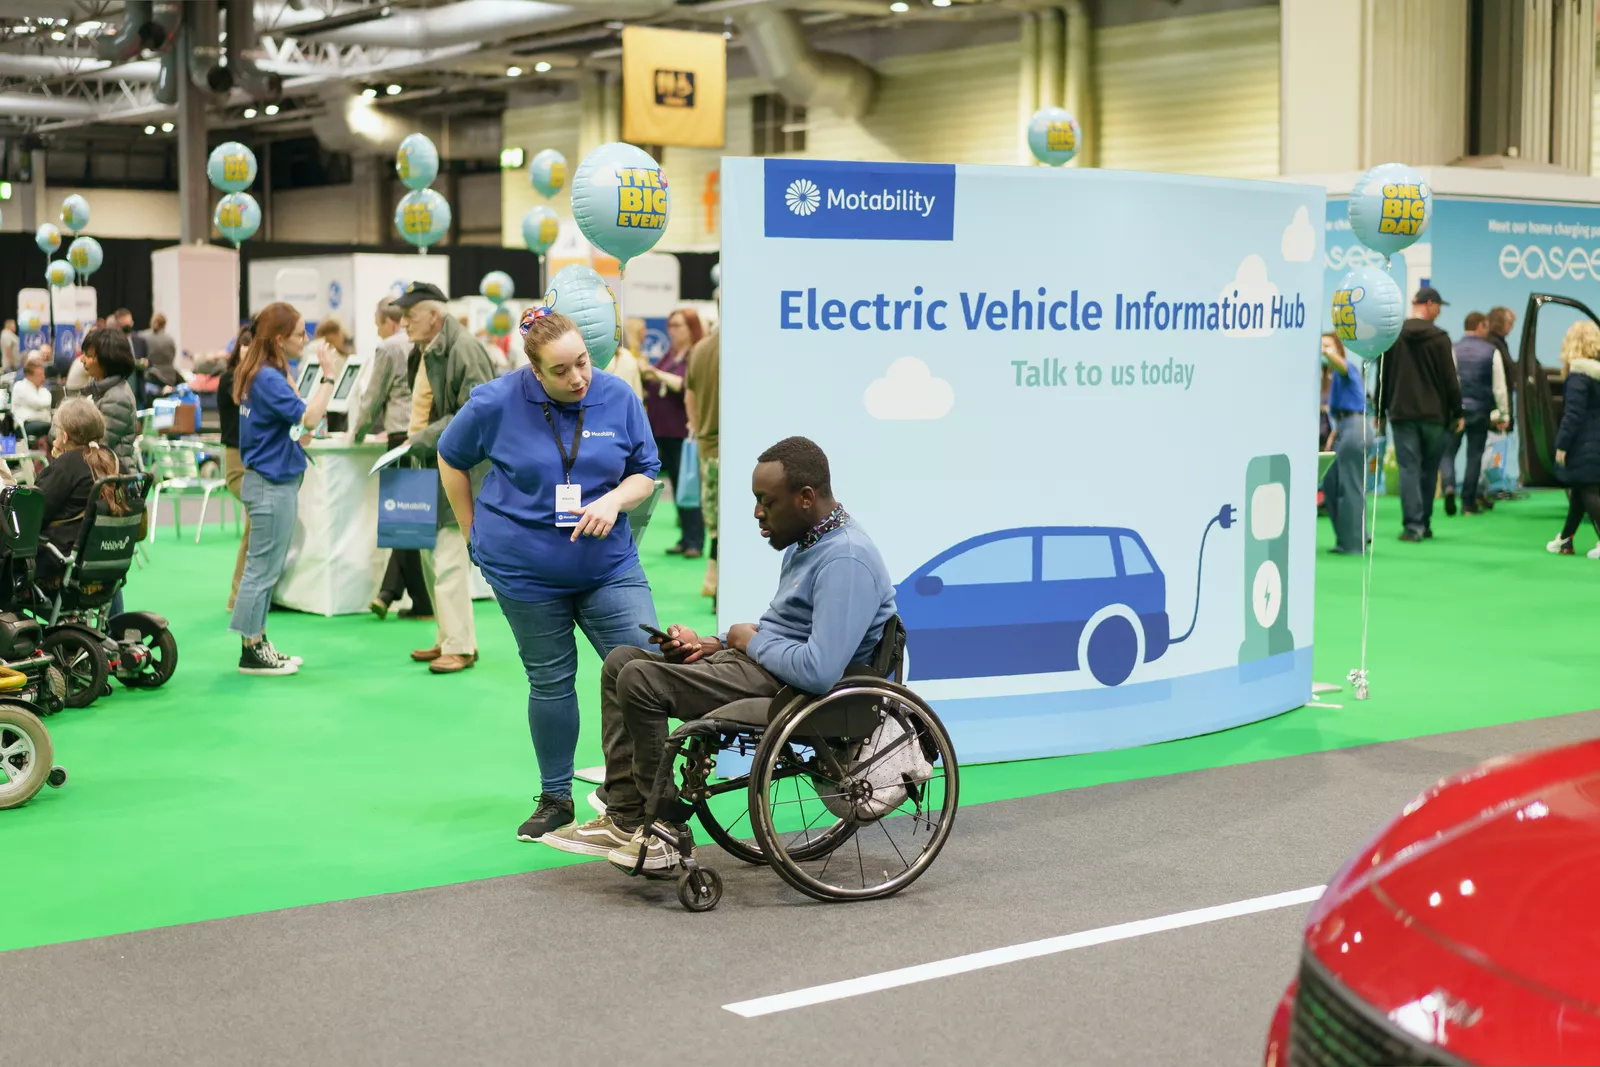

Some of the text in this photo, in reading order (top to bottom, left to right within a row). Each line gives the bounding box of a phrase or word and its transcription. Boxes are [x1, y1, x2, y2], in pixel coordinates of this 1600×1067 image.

[616, 168, 661, 188] THE
[618, 186, 667, 214] BIG
[1382, 183, 1421, 199] ONE
[827, 188, 936, 217] Motability
[1382, 198, 1425, 219] BIG
[617, 212, 666, 229] EVENT
[1379, 218, 1422, 235] DAY
[1528, 219, 1553, 235] home
[1554, 221, 1590, 240] charging
[1332, 289, 1352, 305] NE
[781, 286, 1305, 331] Electric Vehicle Information Hub
[1331, 304, 1355, 325] IG
[1011, 357, 1195, 391] Talk to us today
[397, 501, 432, 512] Motability
